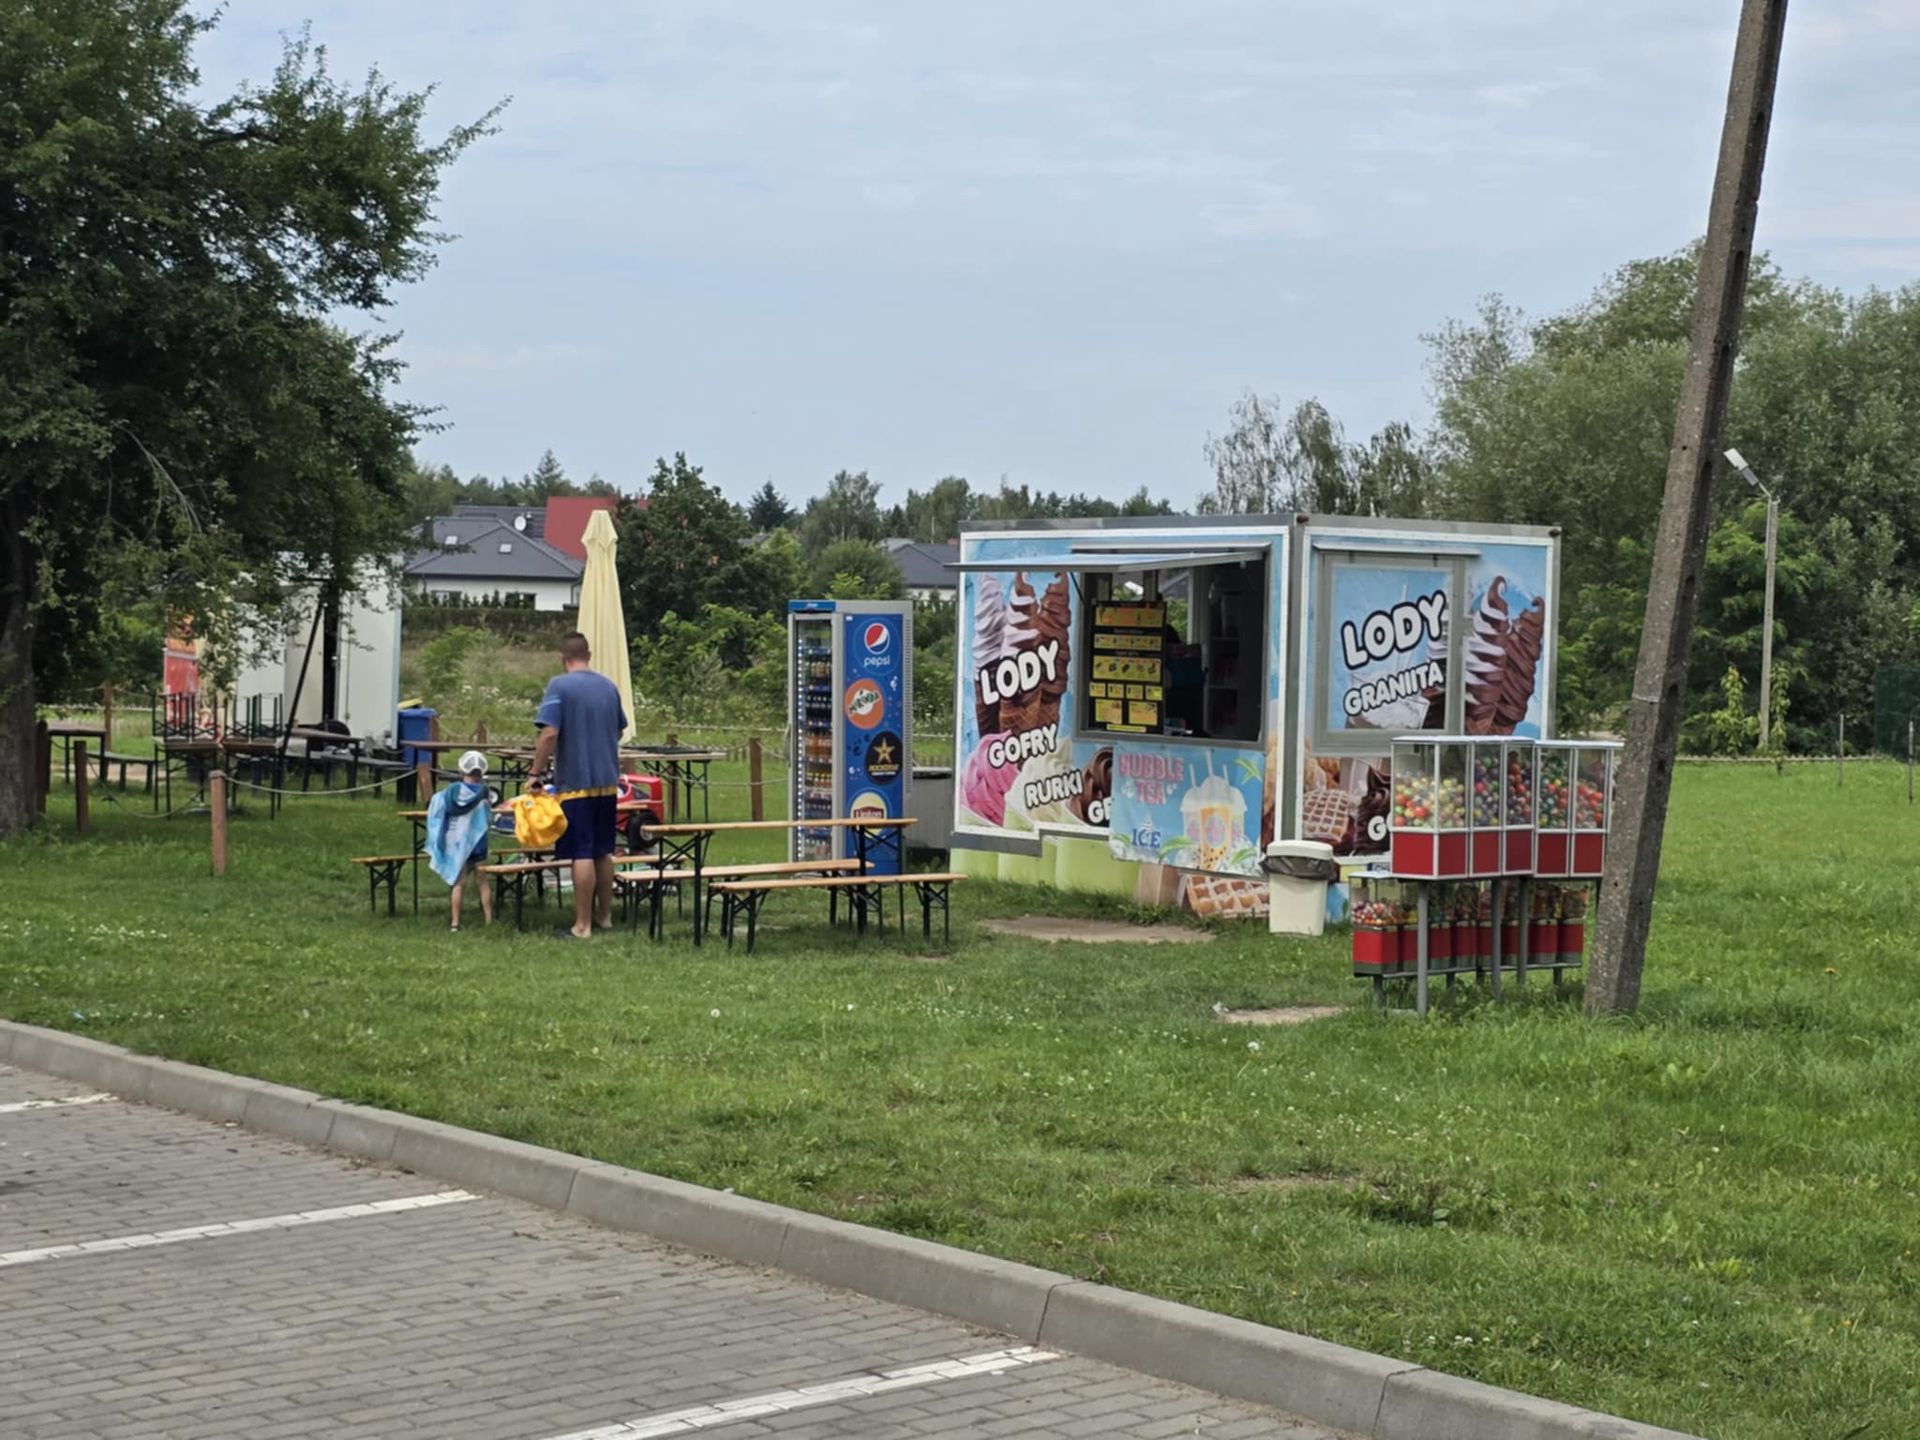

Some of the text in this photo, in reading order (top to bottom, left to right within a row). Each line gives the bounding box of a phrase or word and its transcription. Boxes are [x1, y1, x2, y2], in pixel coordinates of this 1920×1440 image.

[1341, 590, 1446, 670] LODY
[864, 655, 890, 668] pepsi
[979, 639, 1060, 706] LODY
[987, 723, 1057, 768] GOFRY
[1025, 770, 1082, 810] RURKI
[1135, 778, 1167, 805] TEA
[1132, 828, 1162, 848] ICE
